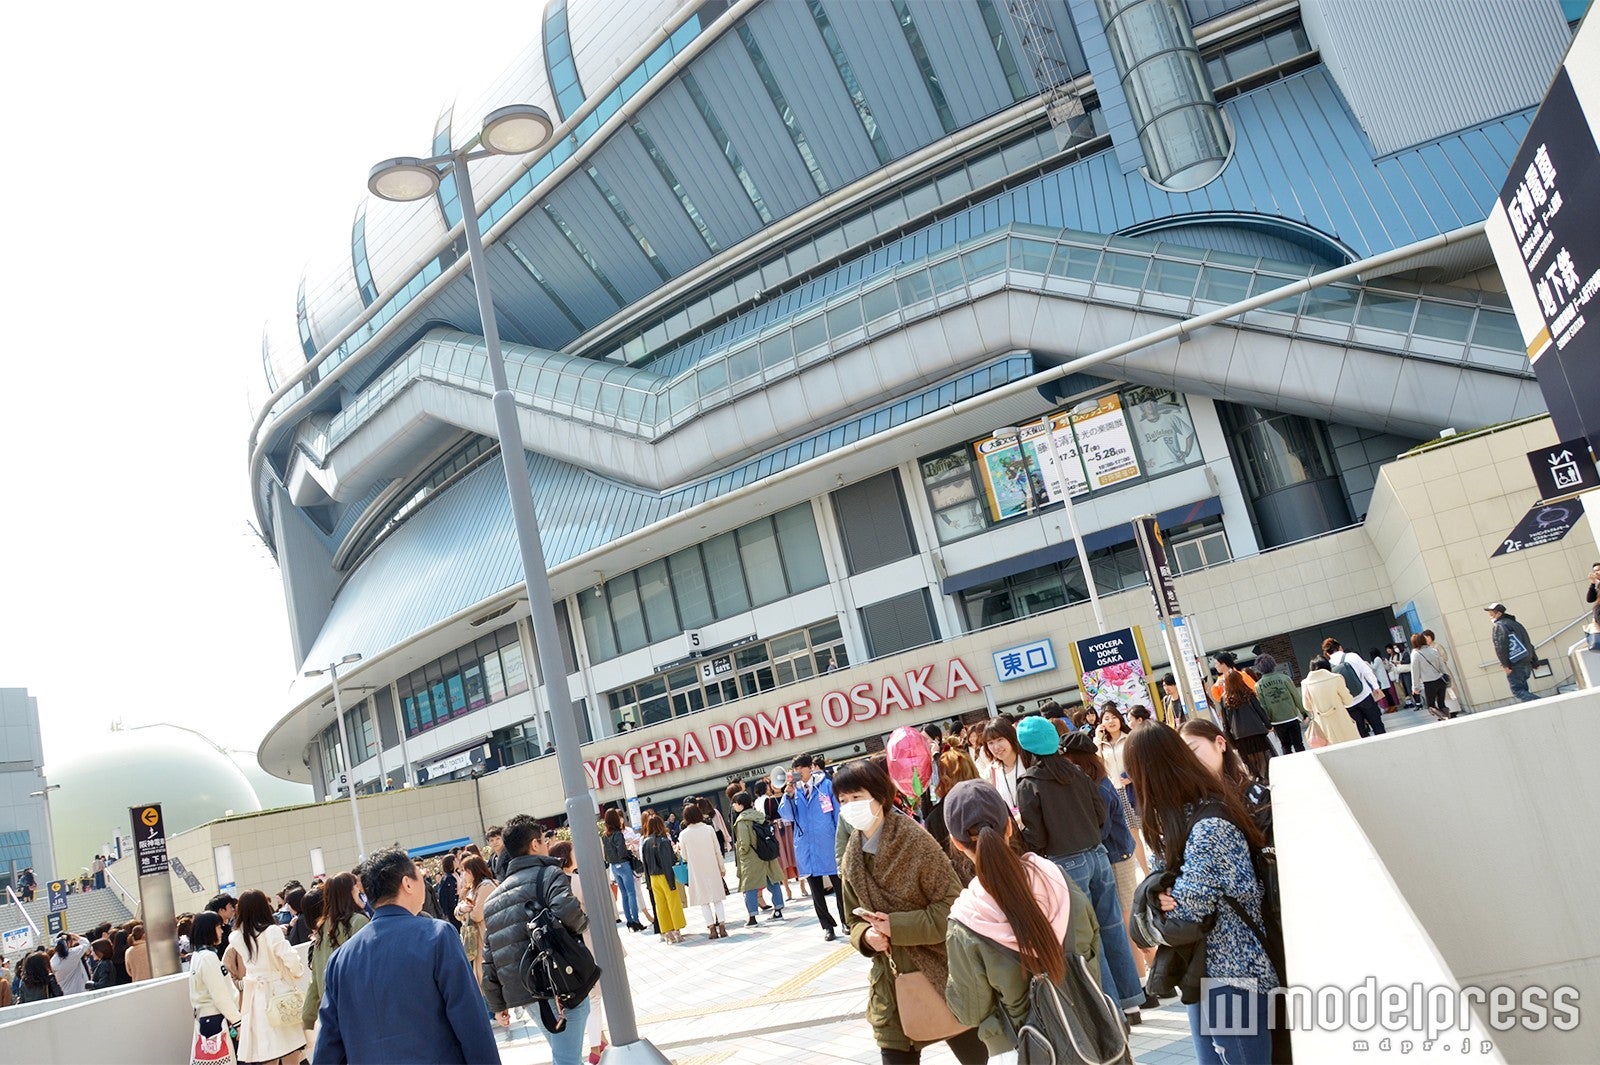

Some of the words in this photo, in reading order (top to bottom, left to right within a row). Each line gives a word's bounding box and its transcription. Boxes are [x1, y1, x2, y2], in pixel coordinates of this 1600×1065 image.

[1507, 143, 1557, 243] 阪神電車
[1536, 246, 1580, 317] 地下鉄
[1504, 539, 1522, 553] 2F
[692, 633, 700, 646] 5
[1088, 638, 1124, 653] KYOCERA
[1097, 647, 1119, 659] DOME
[1000, 646, 1048, 677] 東口
[1096, 654, 1124, 666] OSAKA
[703, 665, 711, 677] 5
[715, 663, 731, 673] GATE
[583, 731, 709, 790] YOCERA
[708, 699, 817, 759] DOME
[820, 657, 982, 728] OSAKA
[751, 767, 766, 777] MALL
[340, 774, 347, 784] 6
[52, 897, 64, 906] JR
